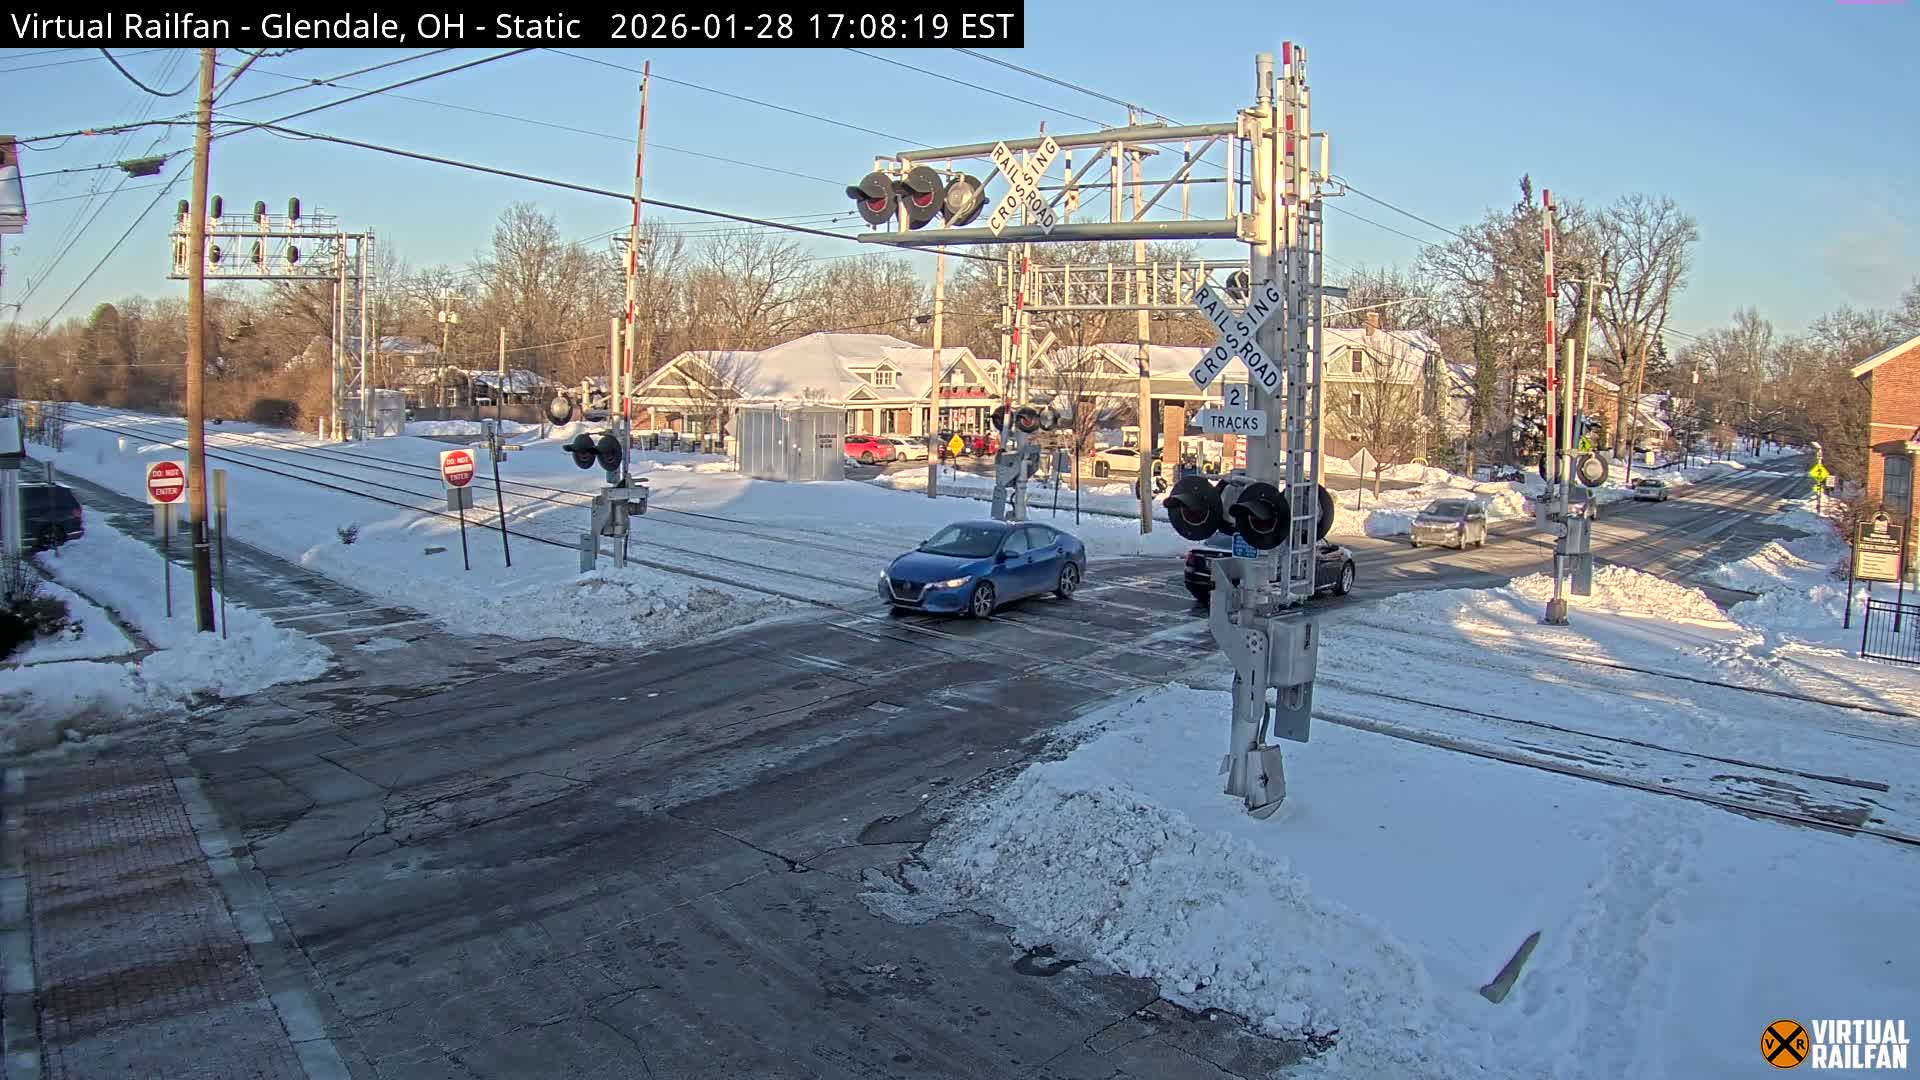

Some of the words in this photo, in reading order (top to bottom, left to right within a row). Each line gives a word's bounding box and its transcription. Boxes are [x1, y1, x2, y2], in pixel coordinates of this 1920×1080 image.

[990, 142, 1056, 230] CROSSING
[1194, 287, 1280, 385] CROSSING
[1211, 415, 1259, 430] TRACKS
[1230, 389, 1240, 406] 2
